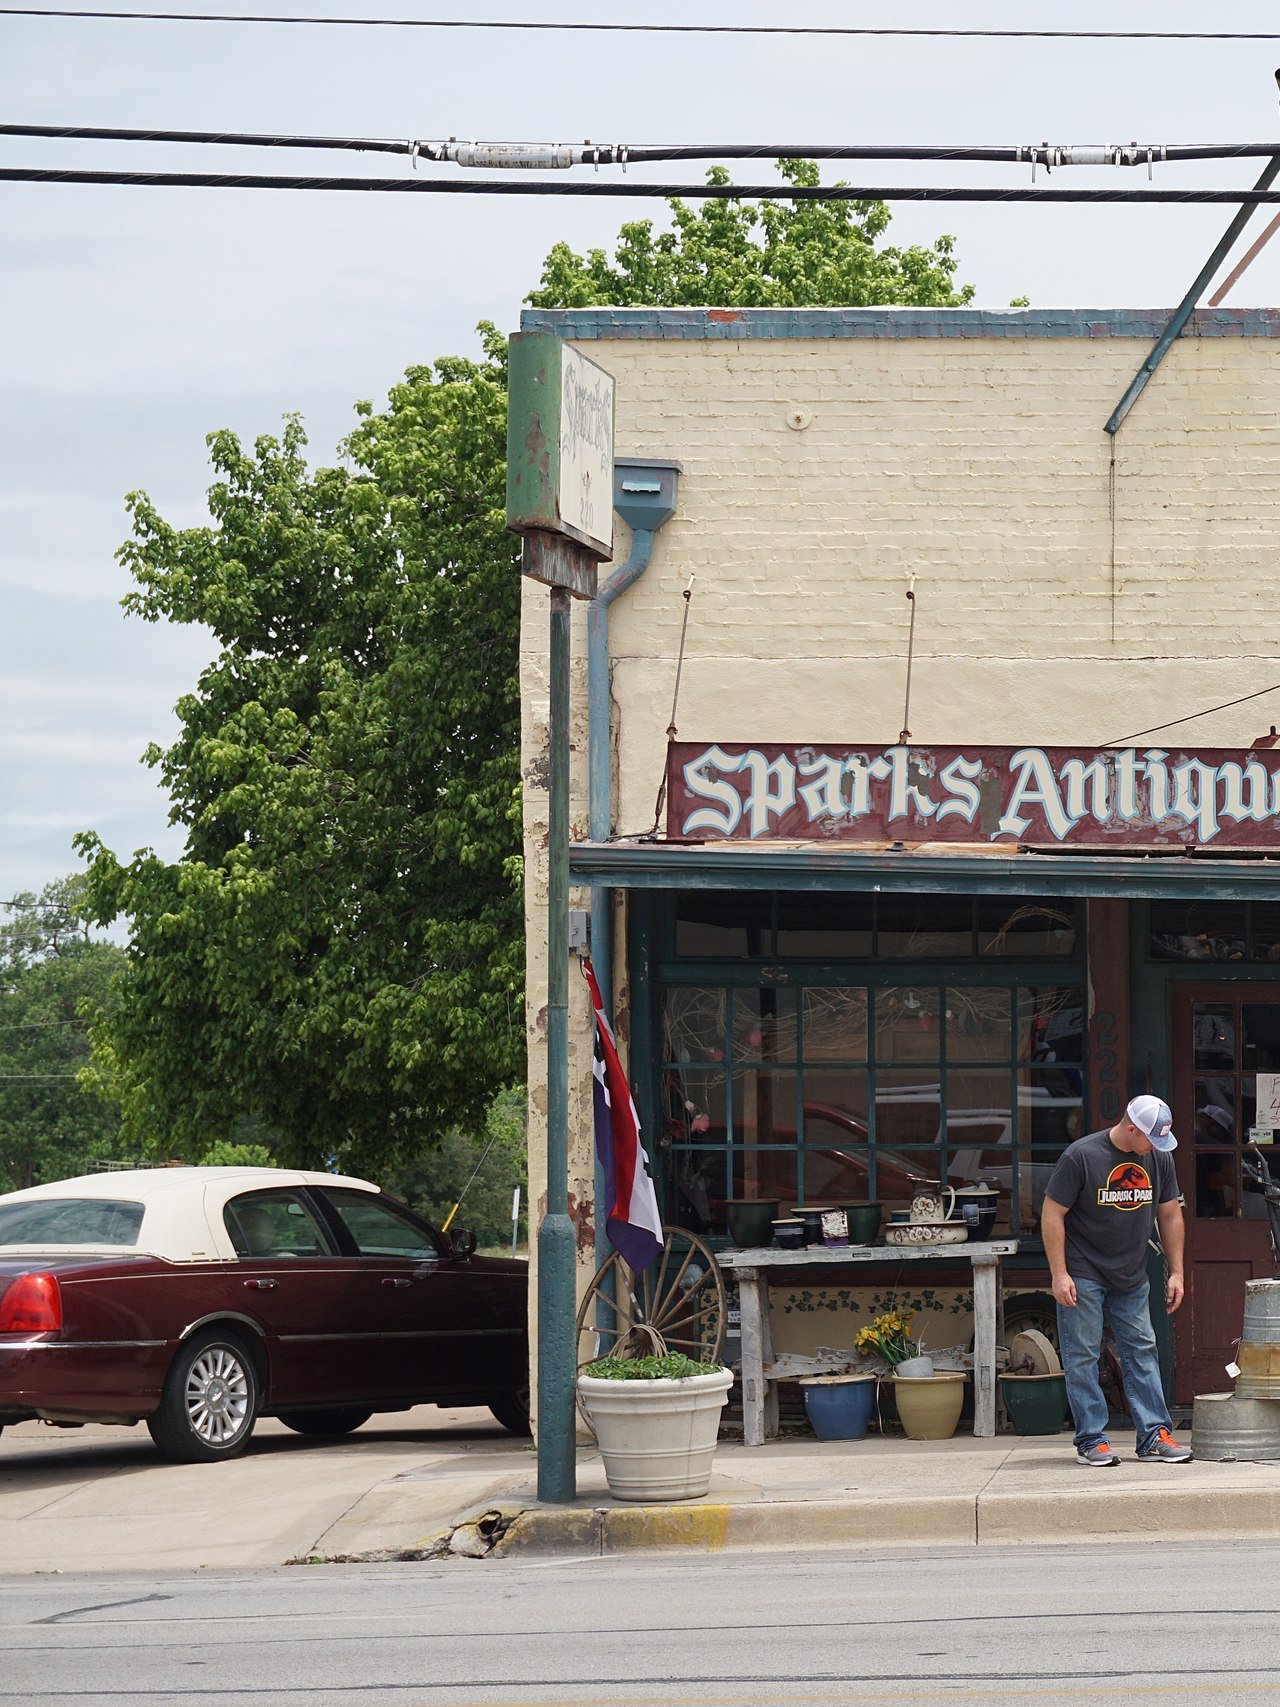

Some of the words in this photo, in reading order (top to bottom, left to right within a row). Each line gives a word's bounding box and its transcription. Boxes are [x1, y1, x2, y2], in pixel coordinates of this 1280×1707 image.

[580, 497, 594, 530] 220
[681, 744, 982, 839] Sparks
[1096, 1011, 1119, 1120] 220
[1100, 1190, 1133, 1203] JURASSIC
